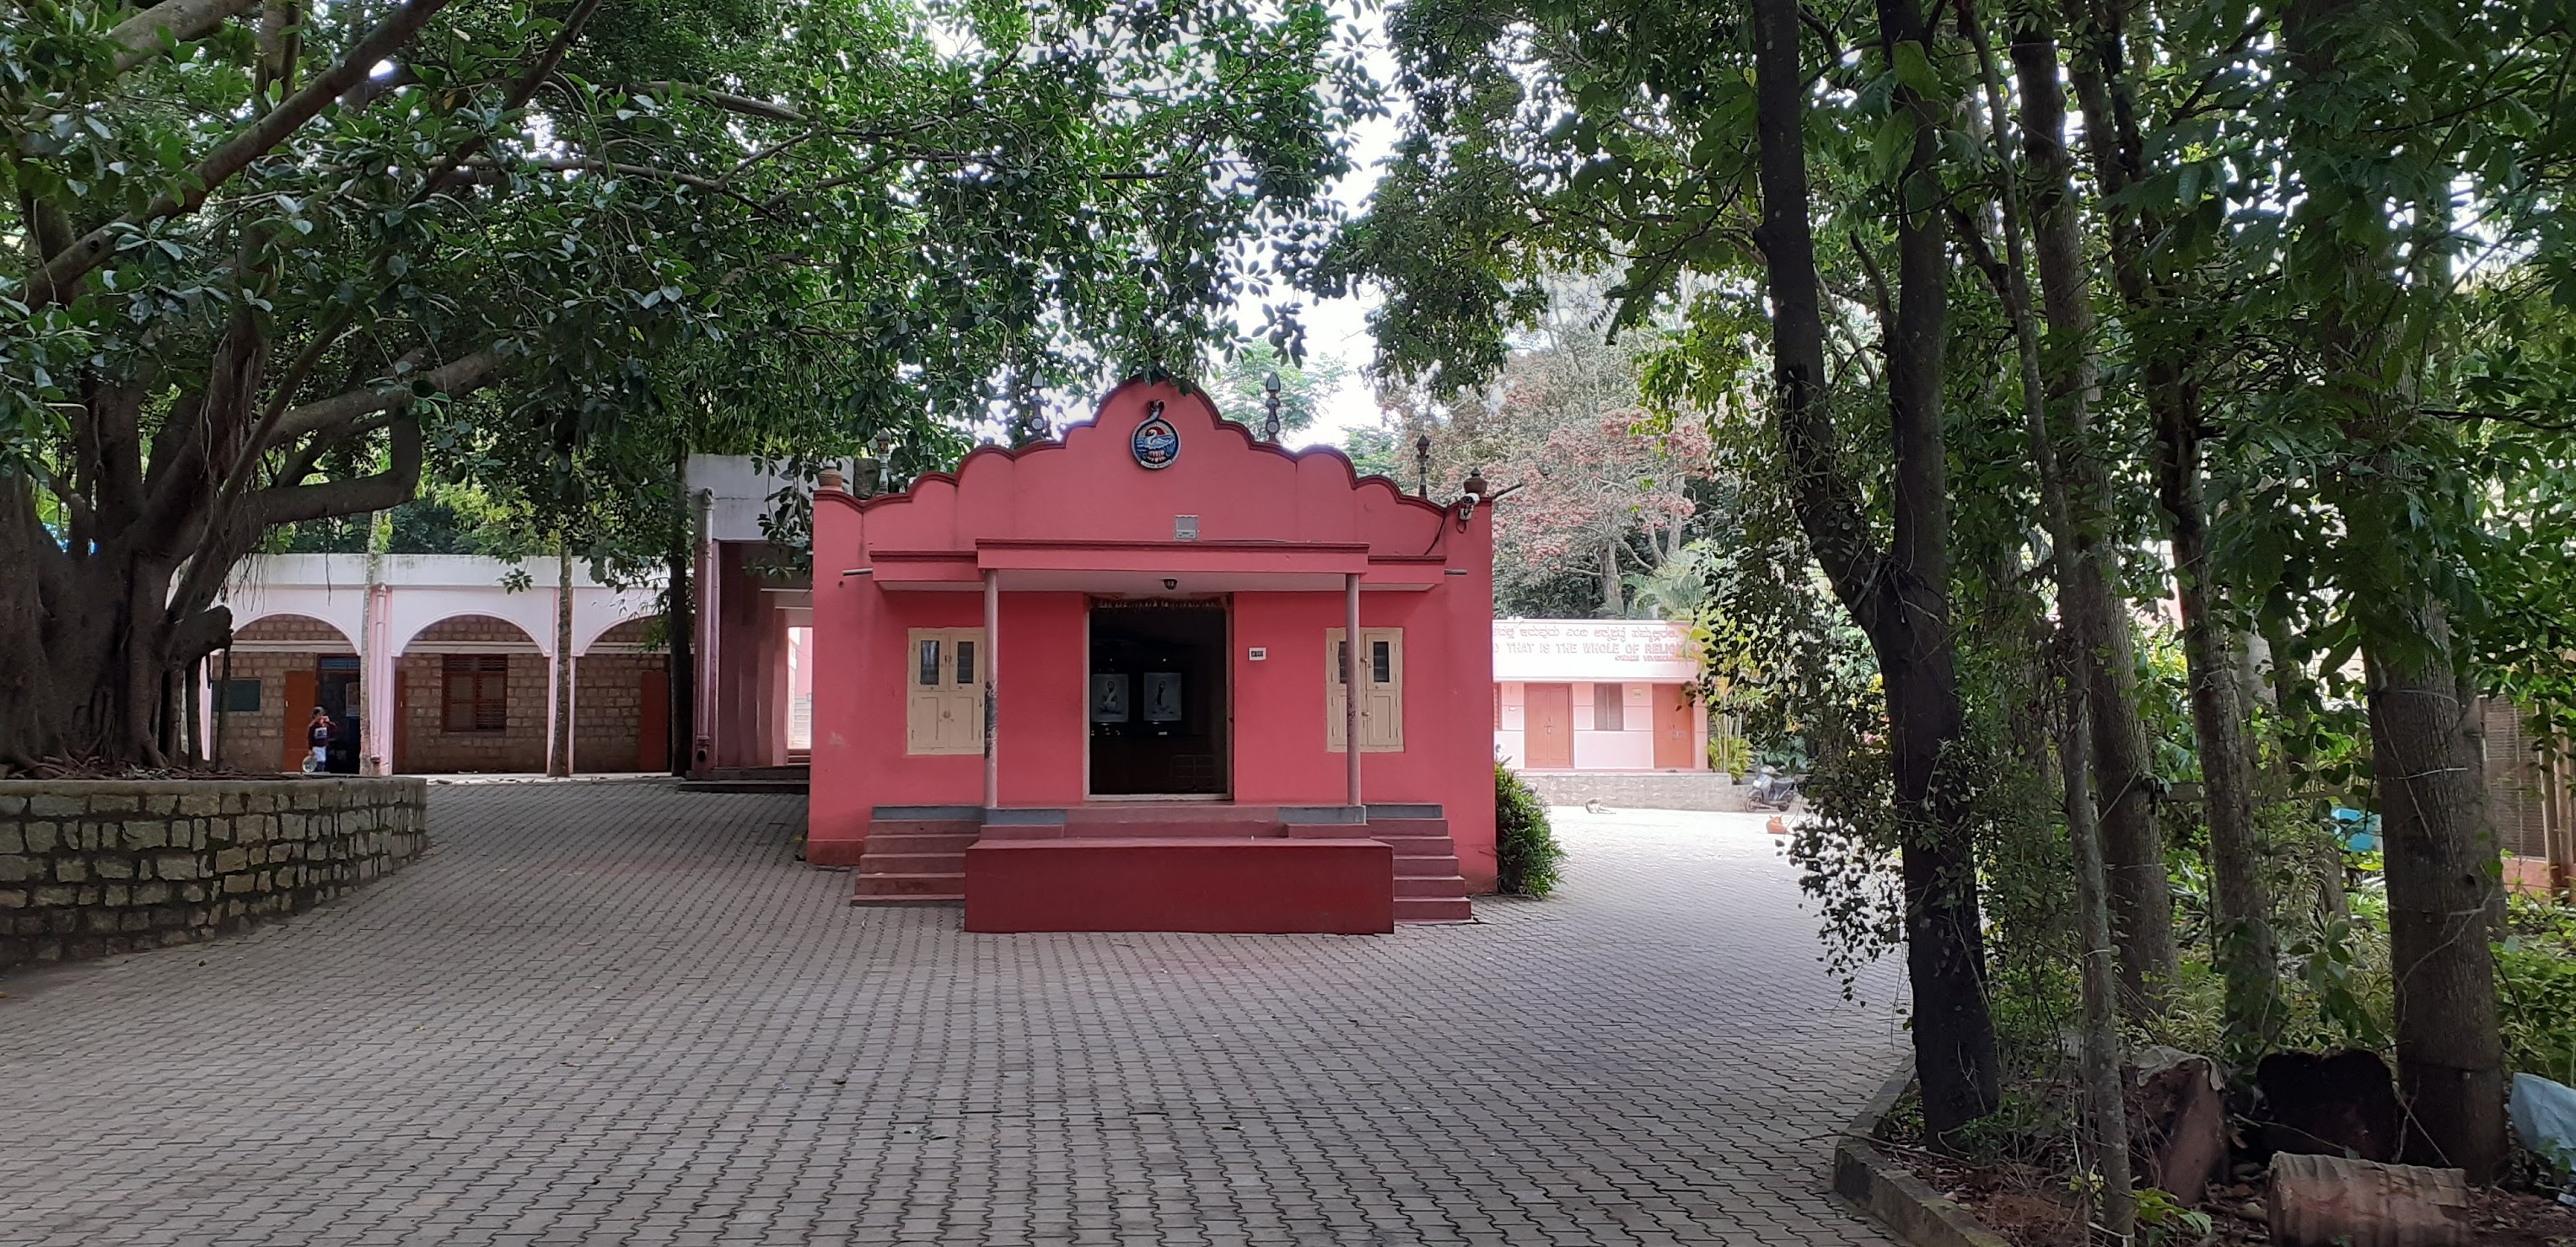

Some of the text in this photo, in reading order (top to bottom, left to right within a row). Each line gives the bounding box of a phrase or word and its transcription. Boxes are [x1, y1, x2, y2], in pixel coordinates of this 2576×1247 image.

[1507, 642, 1535, 653] THAT
[1540, 643, 1551, 653] IS
[1556, 643, 1578, 653] THE
[1583, 643, 1620, 654] WHOLE
[1626, 643, 1640, 654] OF
